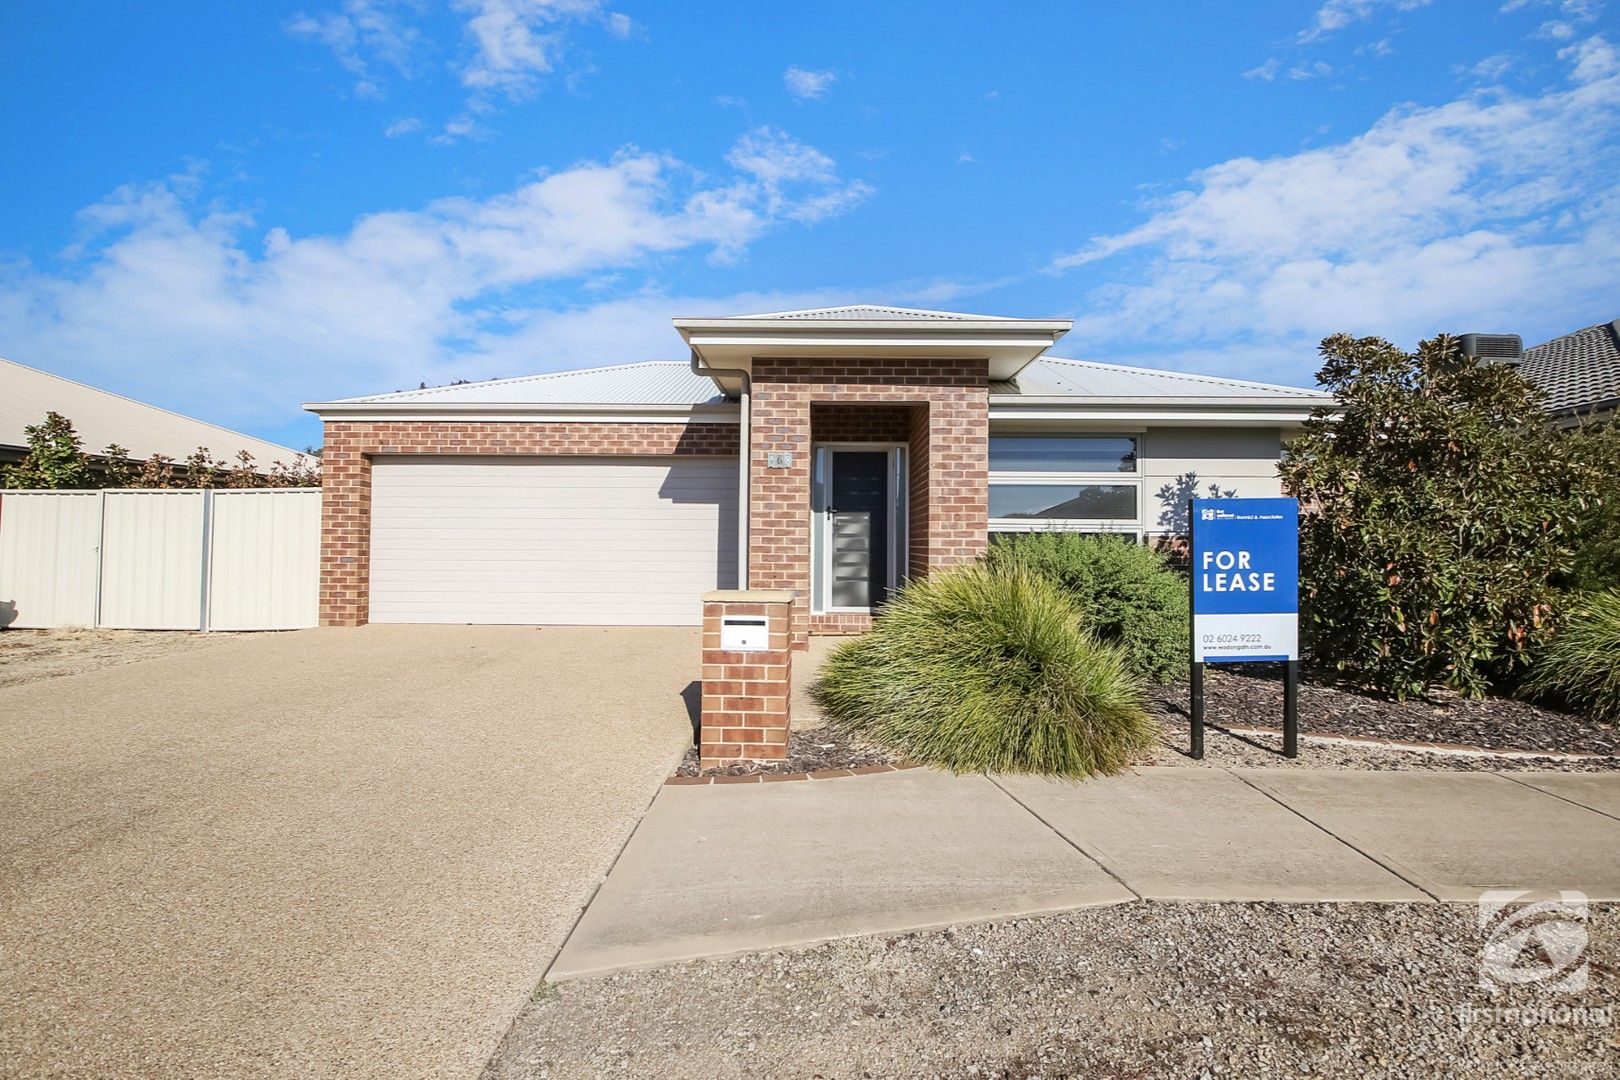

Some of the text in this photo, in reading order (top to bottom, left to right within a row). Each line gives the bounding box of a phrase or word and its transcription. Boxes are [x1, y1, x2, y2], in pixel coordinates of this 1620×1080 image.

[776, 454, 783, 465] 6
[1203, 551, 1251, 570] FOR
[1203, 572, 1275, 592] LEASE
[1203, 633, 1262, 643] 02 6024 9222
